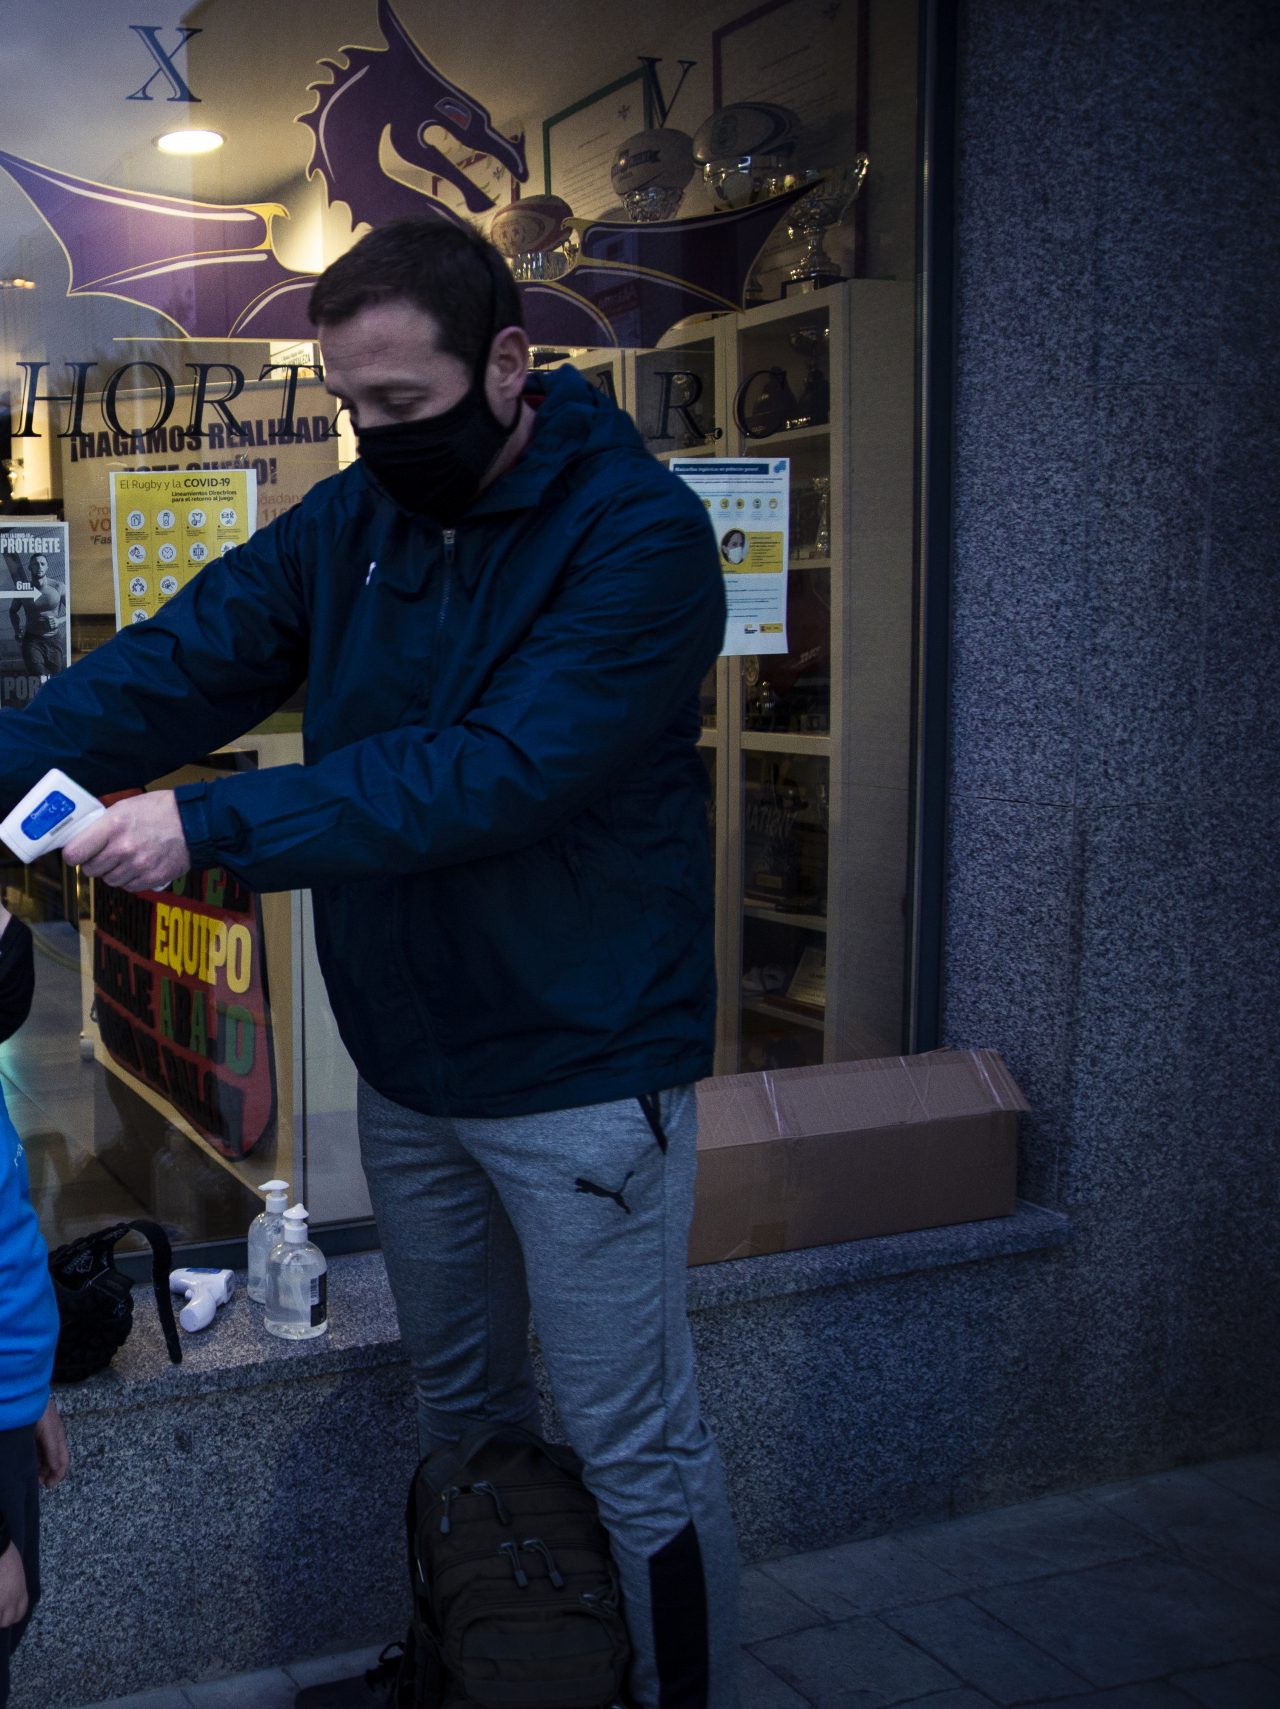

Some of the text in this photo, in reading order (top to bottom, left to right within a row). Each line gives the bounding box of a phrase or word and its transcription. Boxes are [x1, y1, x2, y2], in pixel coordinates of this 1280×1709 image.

[125, 24, 203, 103] X
[638, 56, 696, 128] V
[648, 369, 789, 440] R C
[208, 416, 331, 450] REALIDAD
[120, 477, 231, 491] El Rugby y la COVID-19
[171, 489, 238, 498] Lineamientos Directrices
[171, 496, 185, 504] para
[218, 494, 235, 502] juego
[0, 535, 61, 554] PROTÉGETE
[16, 580, 33, 591] 6m.
[154, 901, 252, 994] EQUIPO
